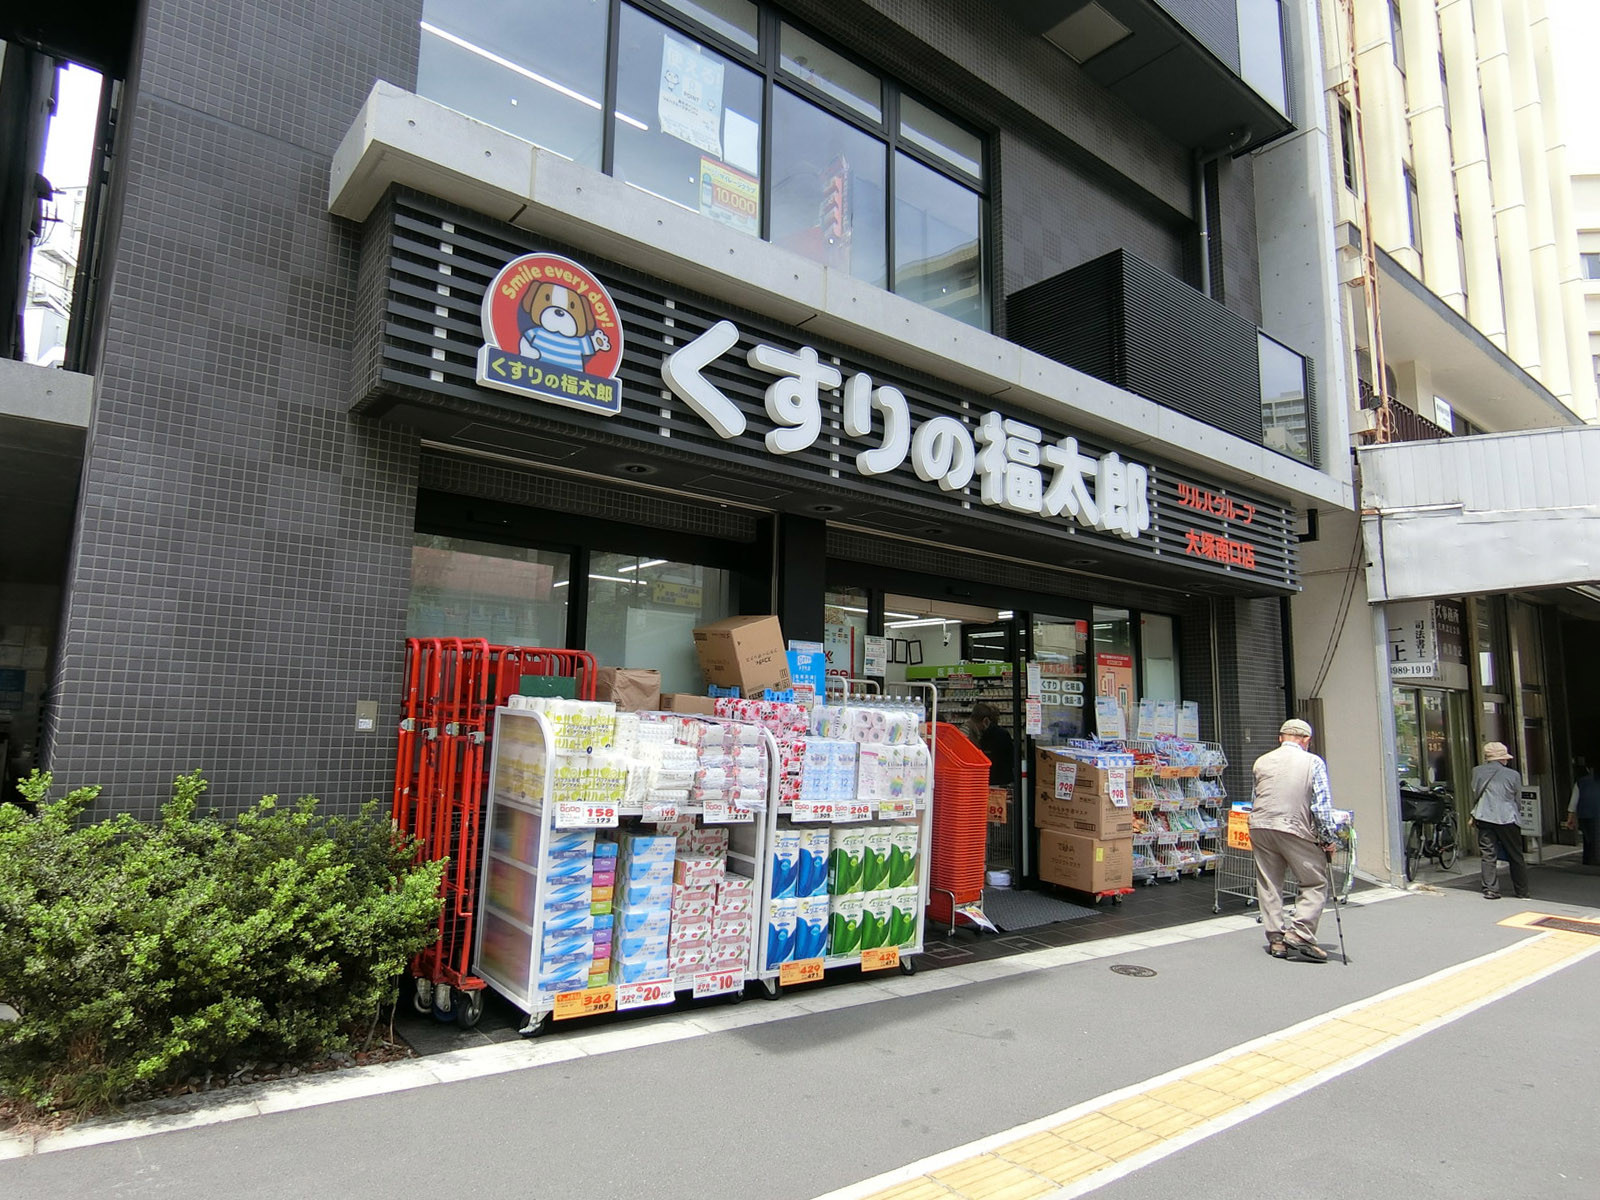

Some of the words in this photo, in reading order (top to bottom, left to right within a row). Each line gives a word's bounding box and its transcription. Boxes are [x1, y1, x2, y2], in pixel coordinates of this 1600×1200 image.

[501, 264, 543, 300] Smile
[544, 265, 590, 294] every
[588, 292, 615, 328] day!
[491, 357, 613, 403] くすりの福太郎
[661, 320, 1149, 539] くすりの福太郎
[1177, 482, 1256, 525] ツルハグループ
[1184, 527, 1256, 570] 大塚南口店
[1415, 620, 1427, 659] 司法書士
[1391, 665, 1432, 675] 989-1919
[1041, 680, 1058, 690] くすり
[587, 808, 614, 818] 158
[812, 805, 833, 814] 278
[850, 805, 869, 814] 268
[989, 806, 1004, 815] 89
[879, 952, 897, 961] 429
[800, 964, 821, 974] 429
[719, 974, 733, 990] 10
[583, 993, 612, 1006] 349
[643, 986, 661, 1001] 20
